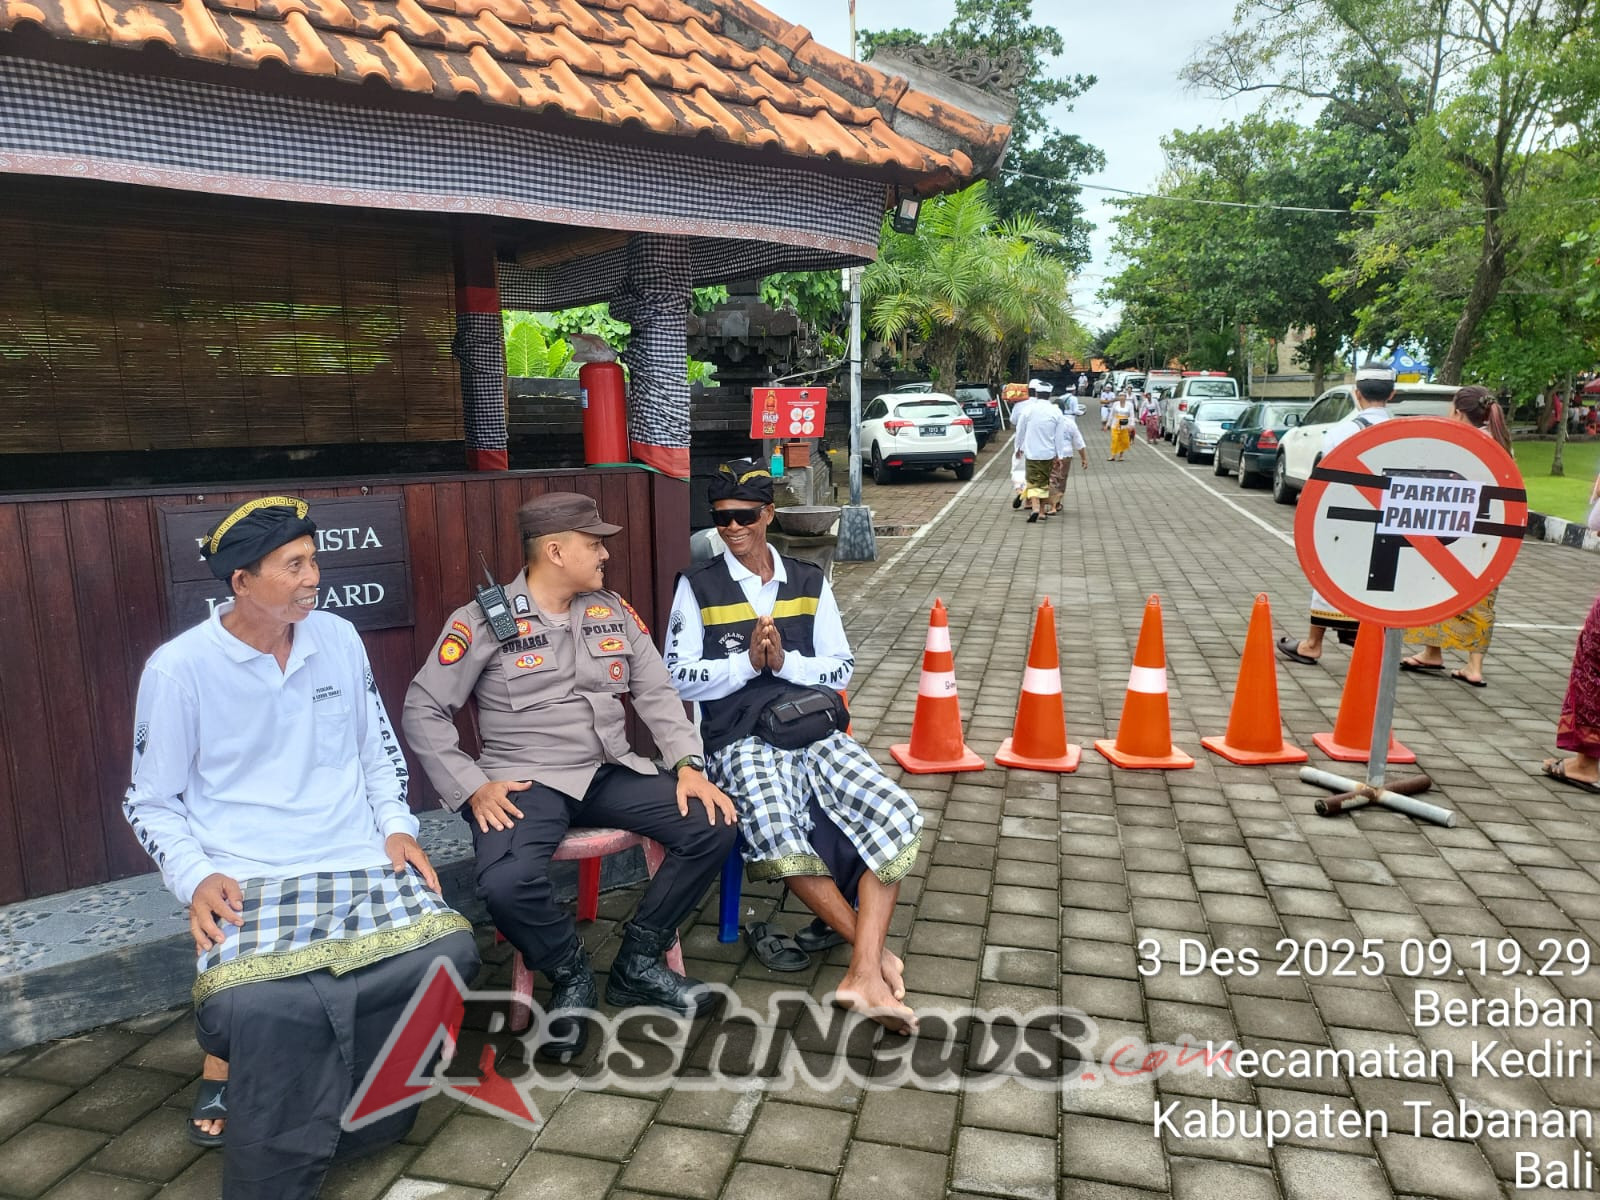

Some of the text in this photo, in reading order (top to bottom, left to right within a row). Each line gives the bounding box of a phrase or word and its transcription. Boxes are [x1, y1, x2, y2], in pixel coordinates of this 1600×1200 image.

[1390, 483, 1477, 503] PARKIR
[1385, 507, 1471, 532] PANITIA
[582, 623, 625, 636] POLRI
